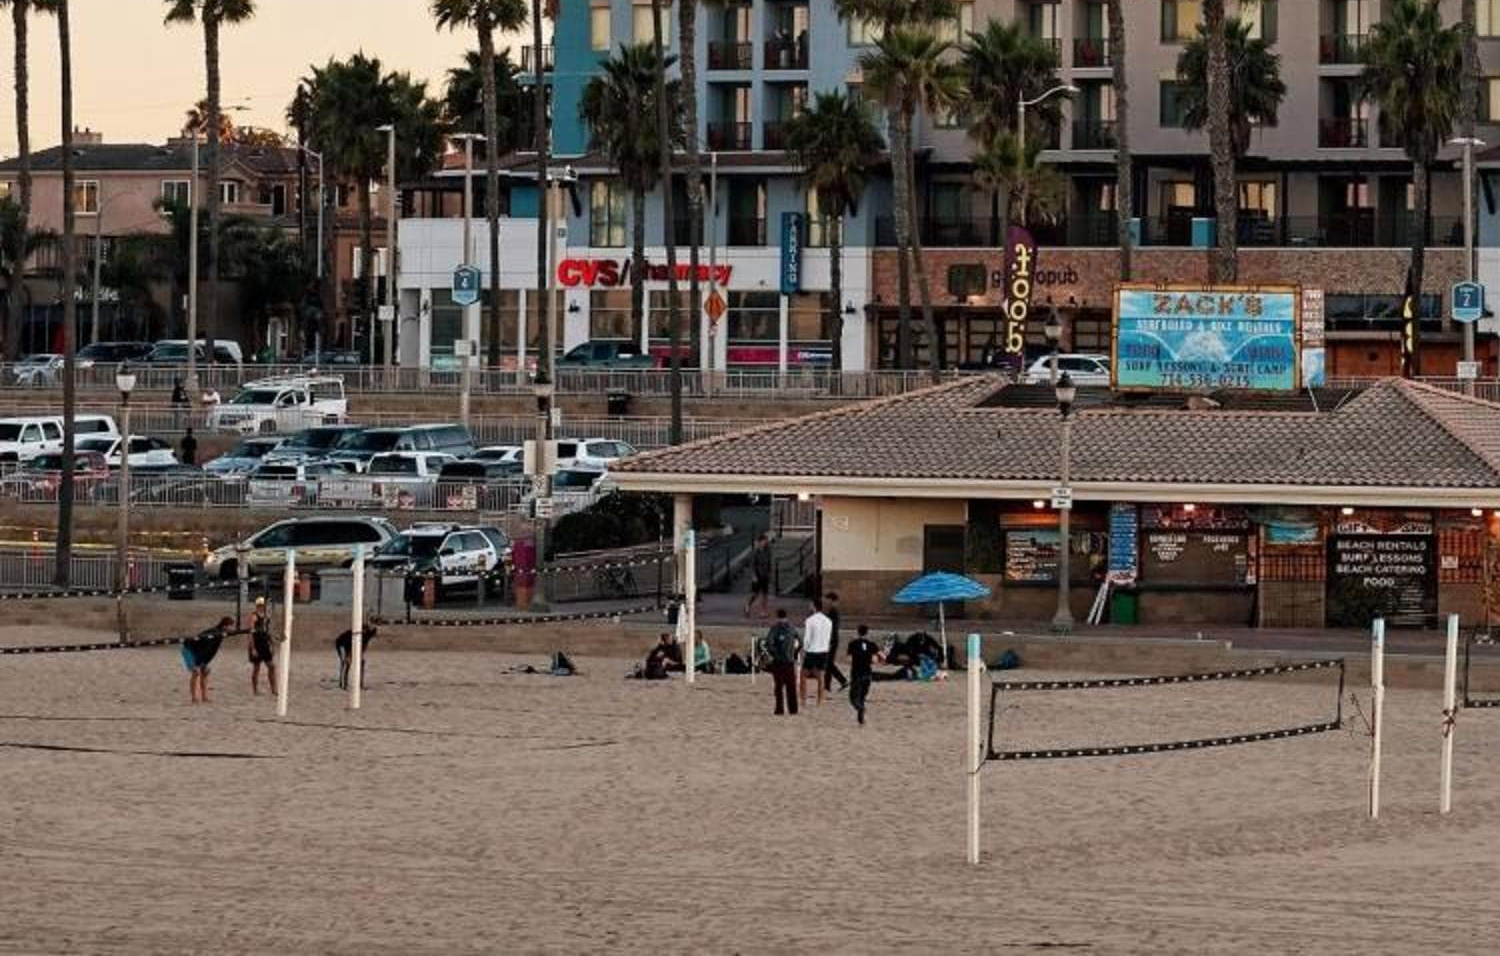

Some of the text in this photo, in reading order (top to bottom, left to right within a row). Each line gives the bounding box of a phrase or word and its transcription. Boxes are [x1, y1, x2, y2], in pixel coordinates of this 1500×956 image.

[991, 266, 1078, 288] gopub
[1153, 295, 1264, 317] ZACK'S
[1337, 540, 1427, 551] BEACH RENTALS
[1363, 577, 1396, 587] FOOD
